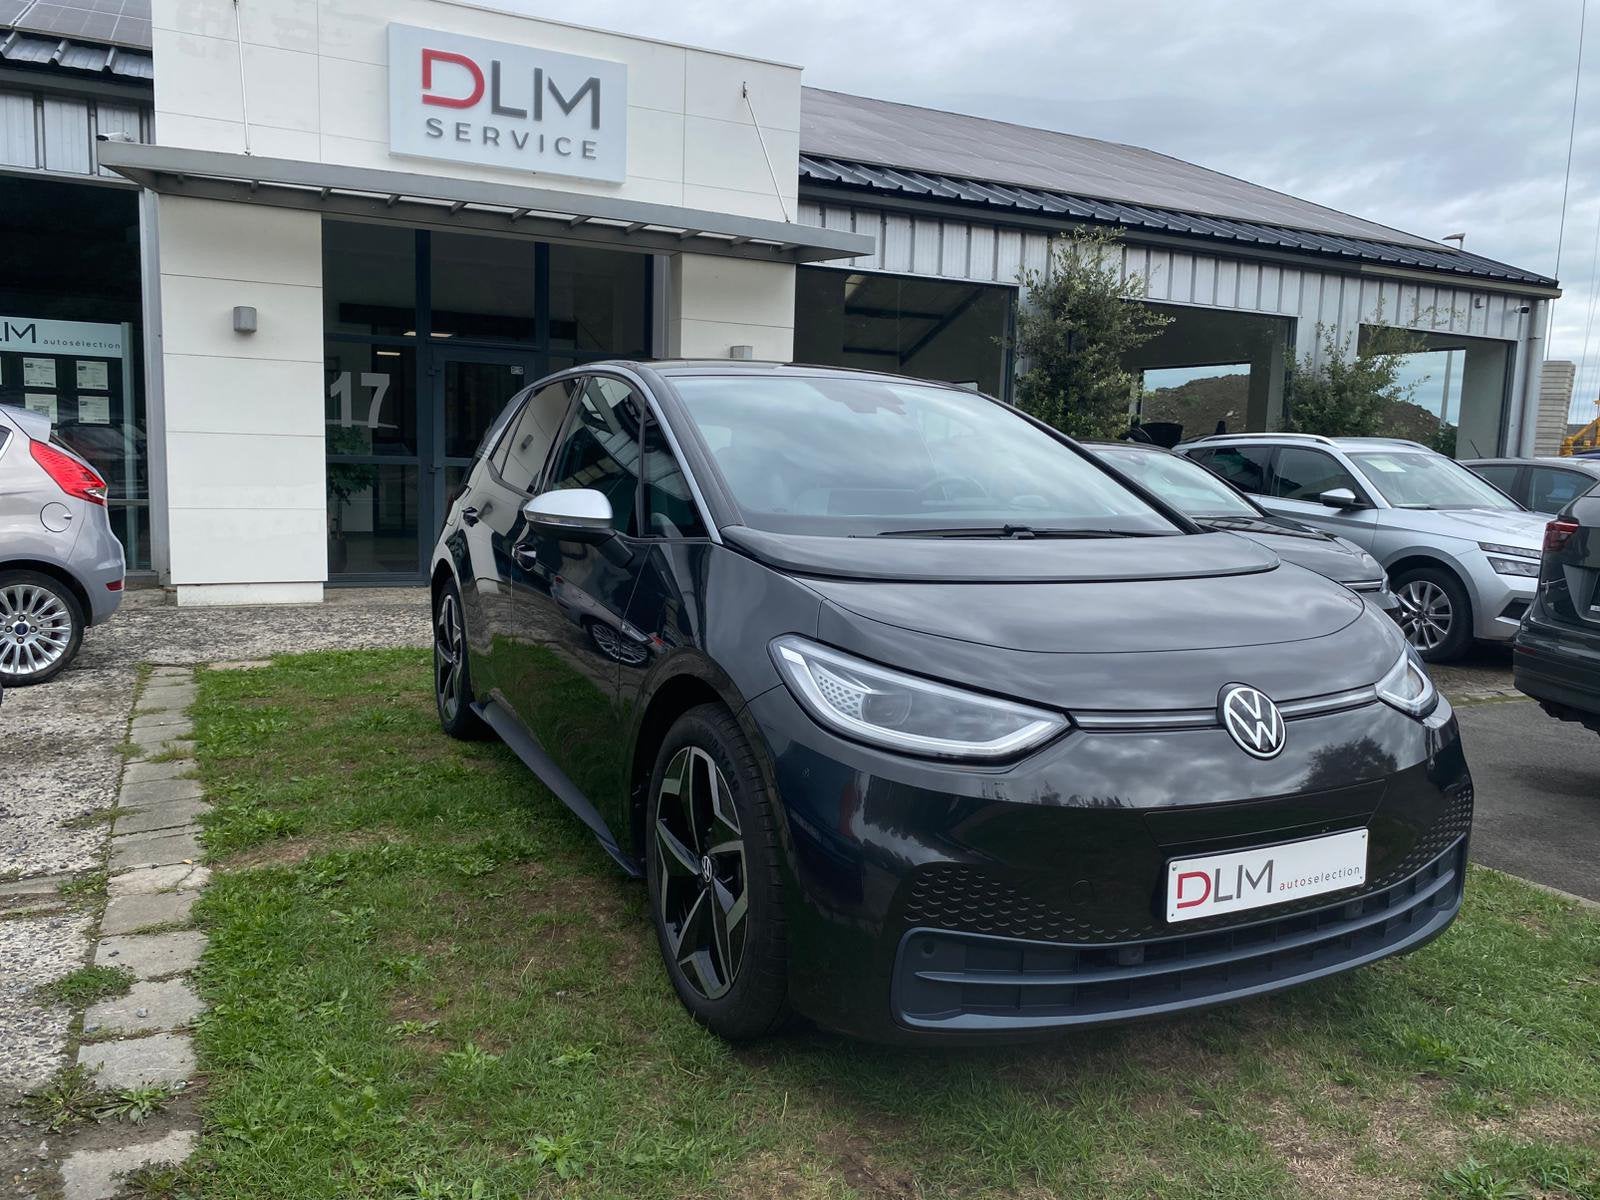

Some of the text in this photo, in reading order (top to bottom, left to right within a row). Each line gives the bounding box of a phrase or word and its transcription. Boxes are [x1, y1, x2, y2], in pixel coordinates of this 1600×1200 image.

[426, 118, 597, 160] SERVICE
[330, 371, 391, 428] 17
[1280, 866, 1360, 891] autoselection
